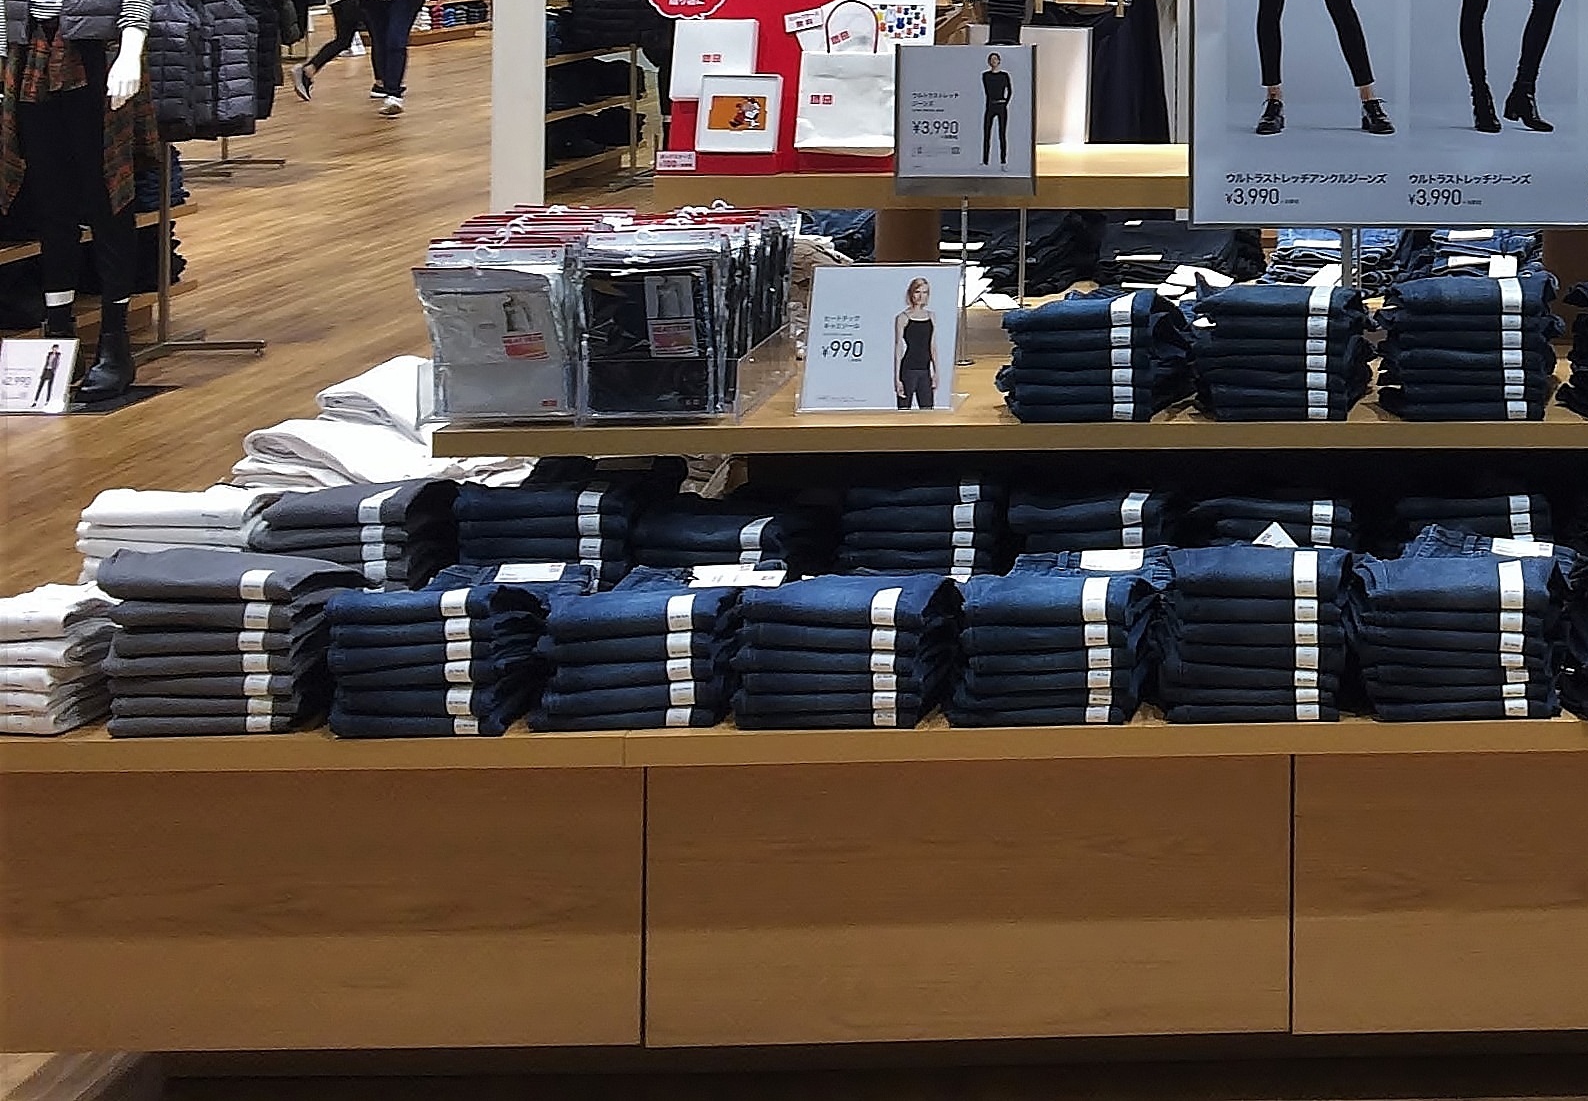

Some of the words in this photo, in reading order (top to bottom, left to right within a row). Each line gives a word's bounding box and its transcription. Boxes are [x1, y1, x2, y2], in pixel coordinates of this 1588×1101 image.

[912, 120, 959, 135] ¥3,990
[1225, 173, 1389, 185] ウルトラストレッチアンクルジーンズ
[1408, 173, 1532, 185] ウルトラストレッチジーンズ
[1225, 188, 1280, 206] ¥3,990
[1408, 189, 1462, 207] ¥3,990
[822, 340, 864, 358] ¥990
